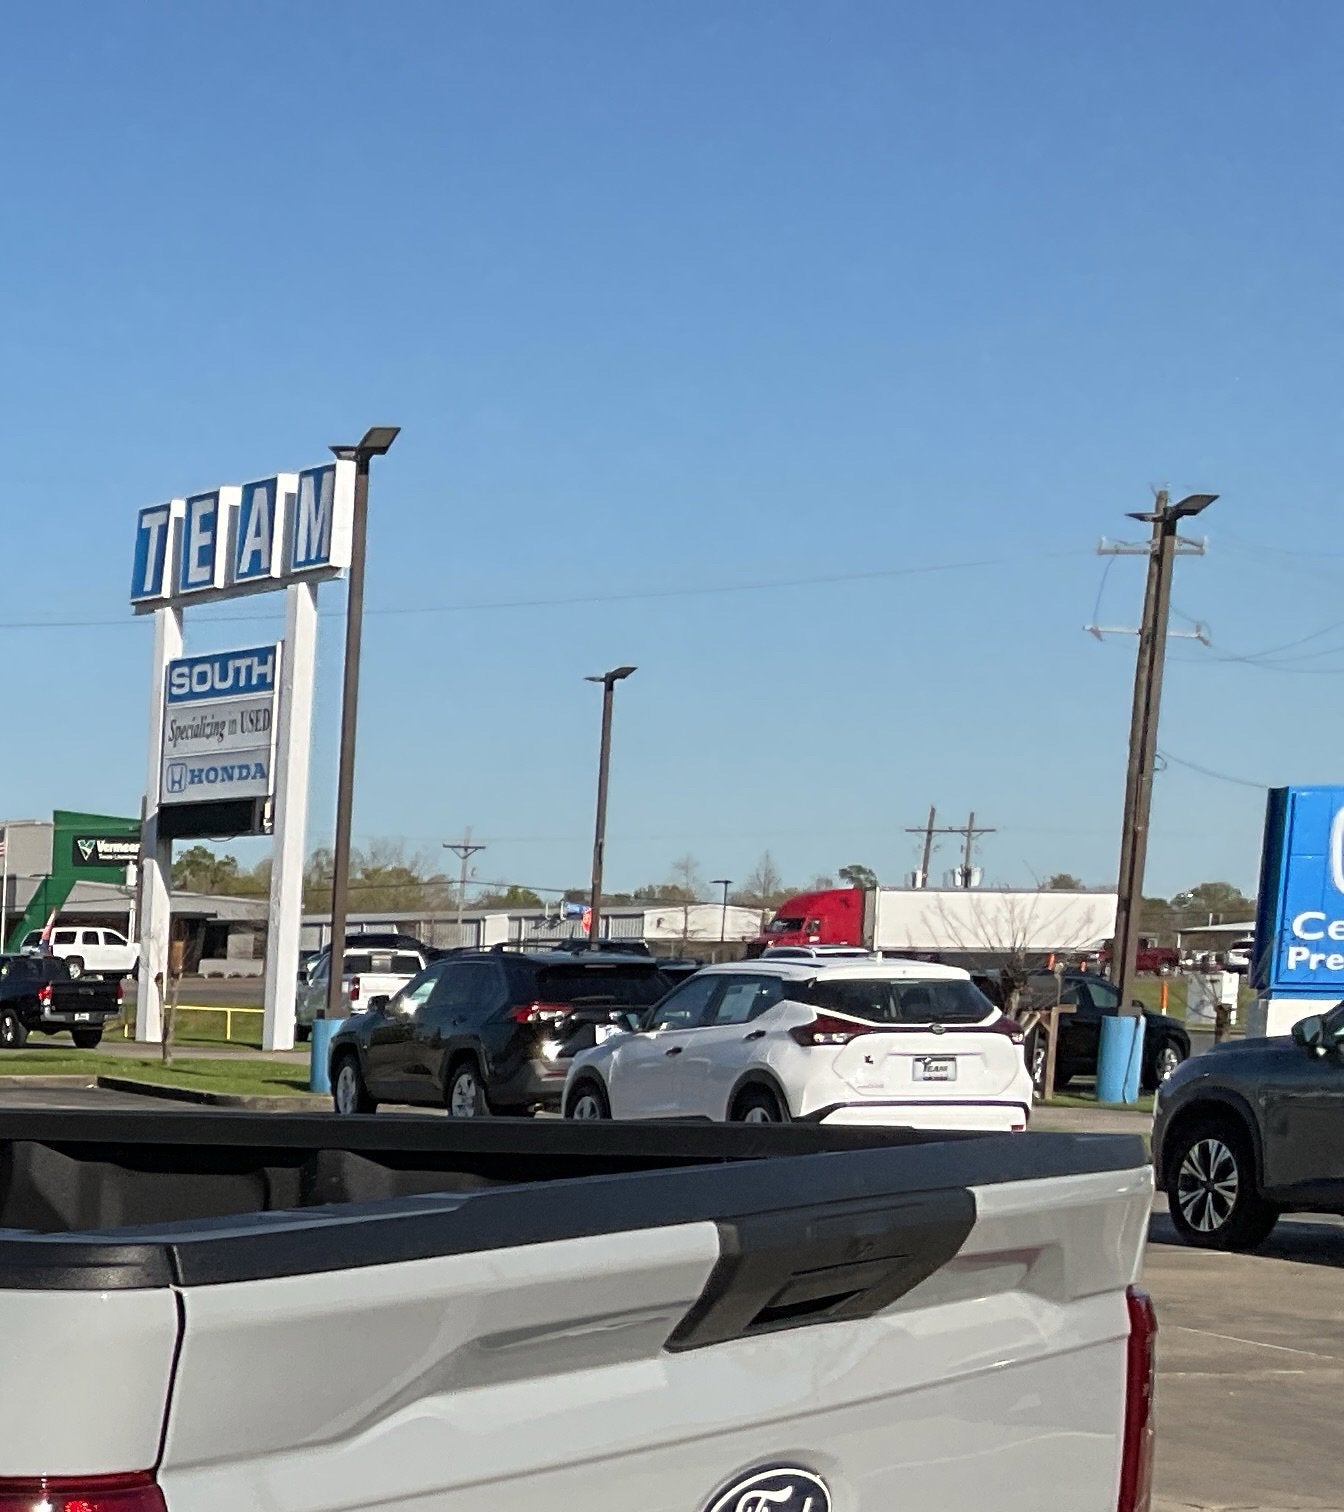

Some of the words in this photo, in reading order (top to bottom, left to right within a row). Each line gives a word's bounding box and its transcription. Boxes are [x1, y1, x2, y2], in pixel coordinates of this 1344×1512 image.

[141, 470, 335, 592] TEAM
[171, 655, 273, 695] SOUTH
[168, 715, 226, 748] Specializing
[240, 708, 271, 734] USED
[188, 762, 267, 785] HONDA
